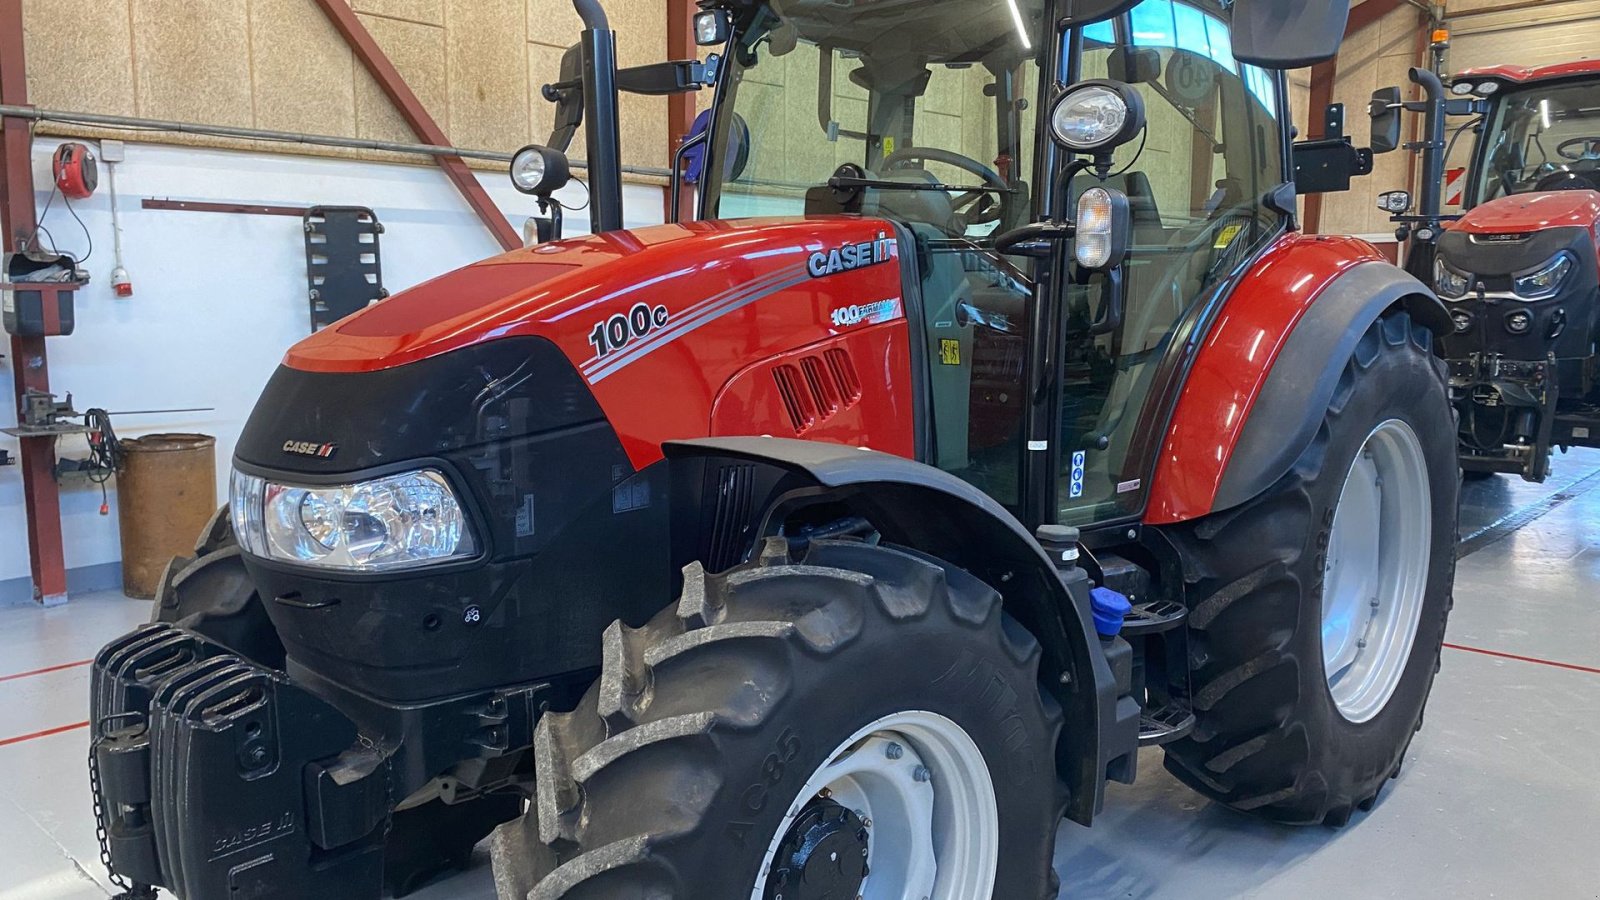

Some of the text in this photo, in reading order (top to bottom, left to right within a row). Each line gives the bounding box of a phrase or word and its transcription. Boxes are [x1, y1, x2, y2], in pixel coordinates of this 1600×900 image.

[808, 242, 871, 278] CASE
[830, 304, 859, 326] 100
[283, 440, 318, 455] CASE
[212, 821, 272, 852] CASE
